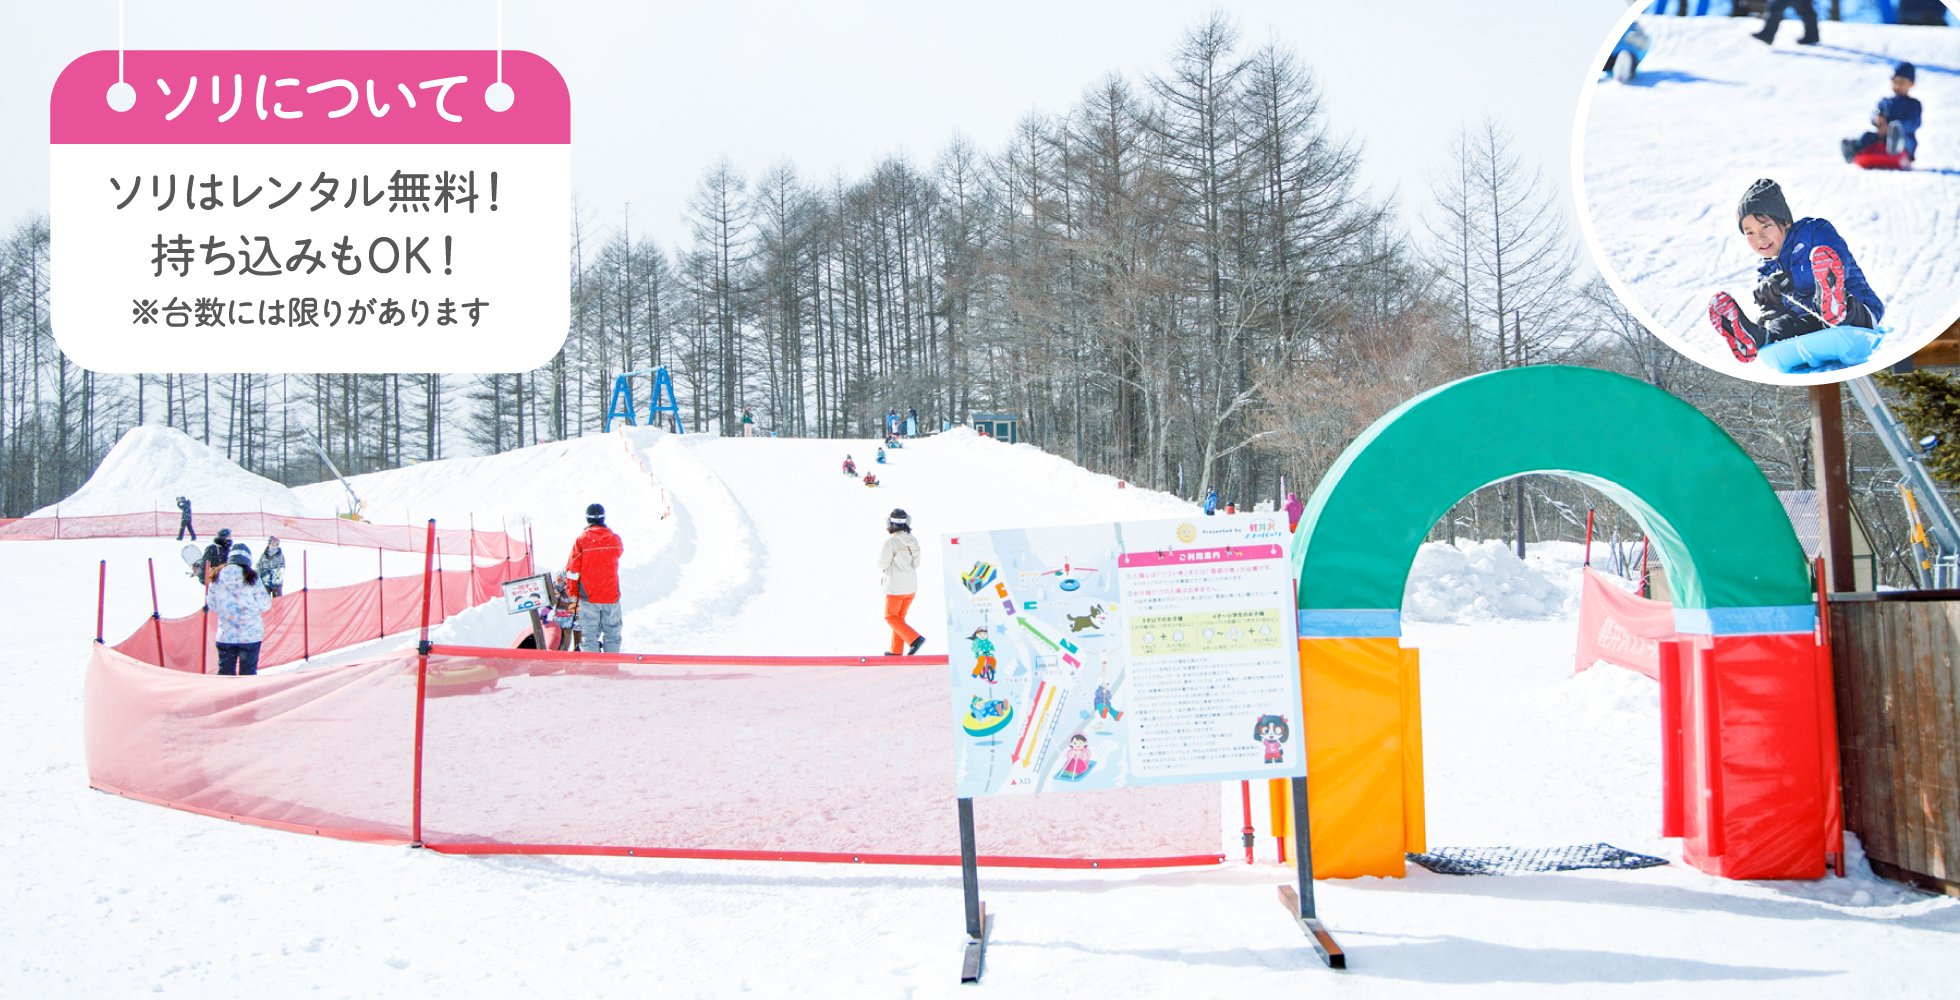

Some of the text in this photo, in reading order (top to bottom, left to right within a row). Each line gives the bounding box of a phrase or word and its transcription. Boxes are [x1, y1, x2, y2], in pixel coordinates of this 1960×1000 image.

[1179, 551, 1220, 561] ご利用案内
